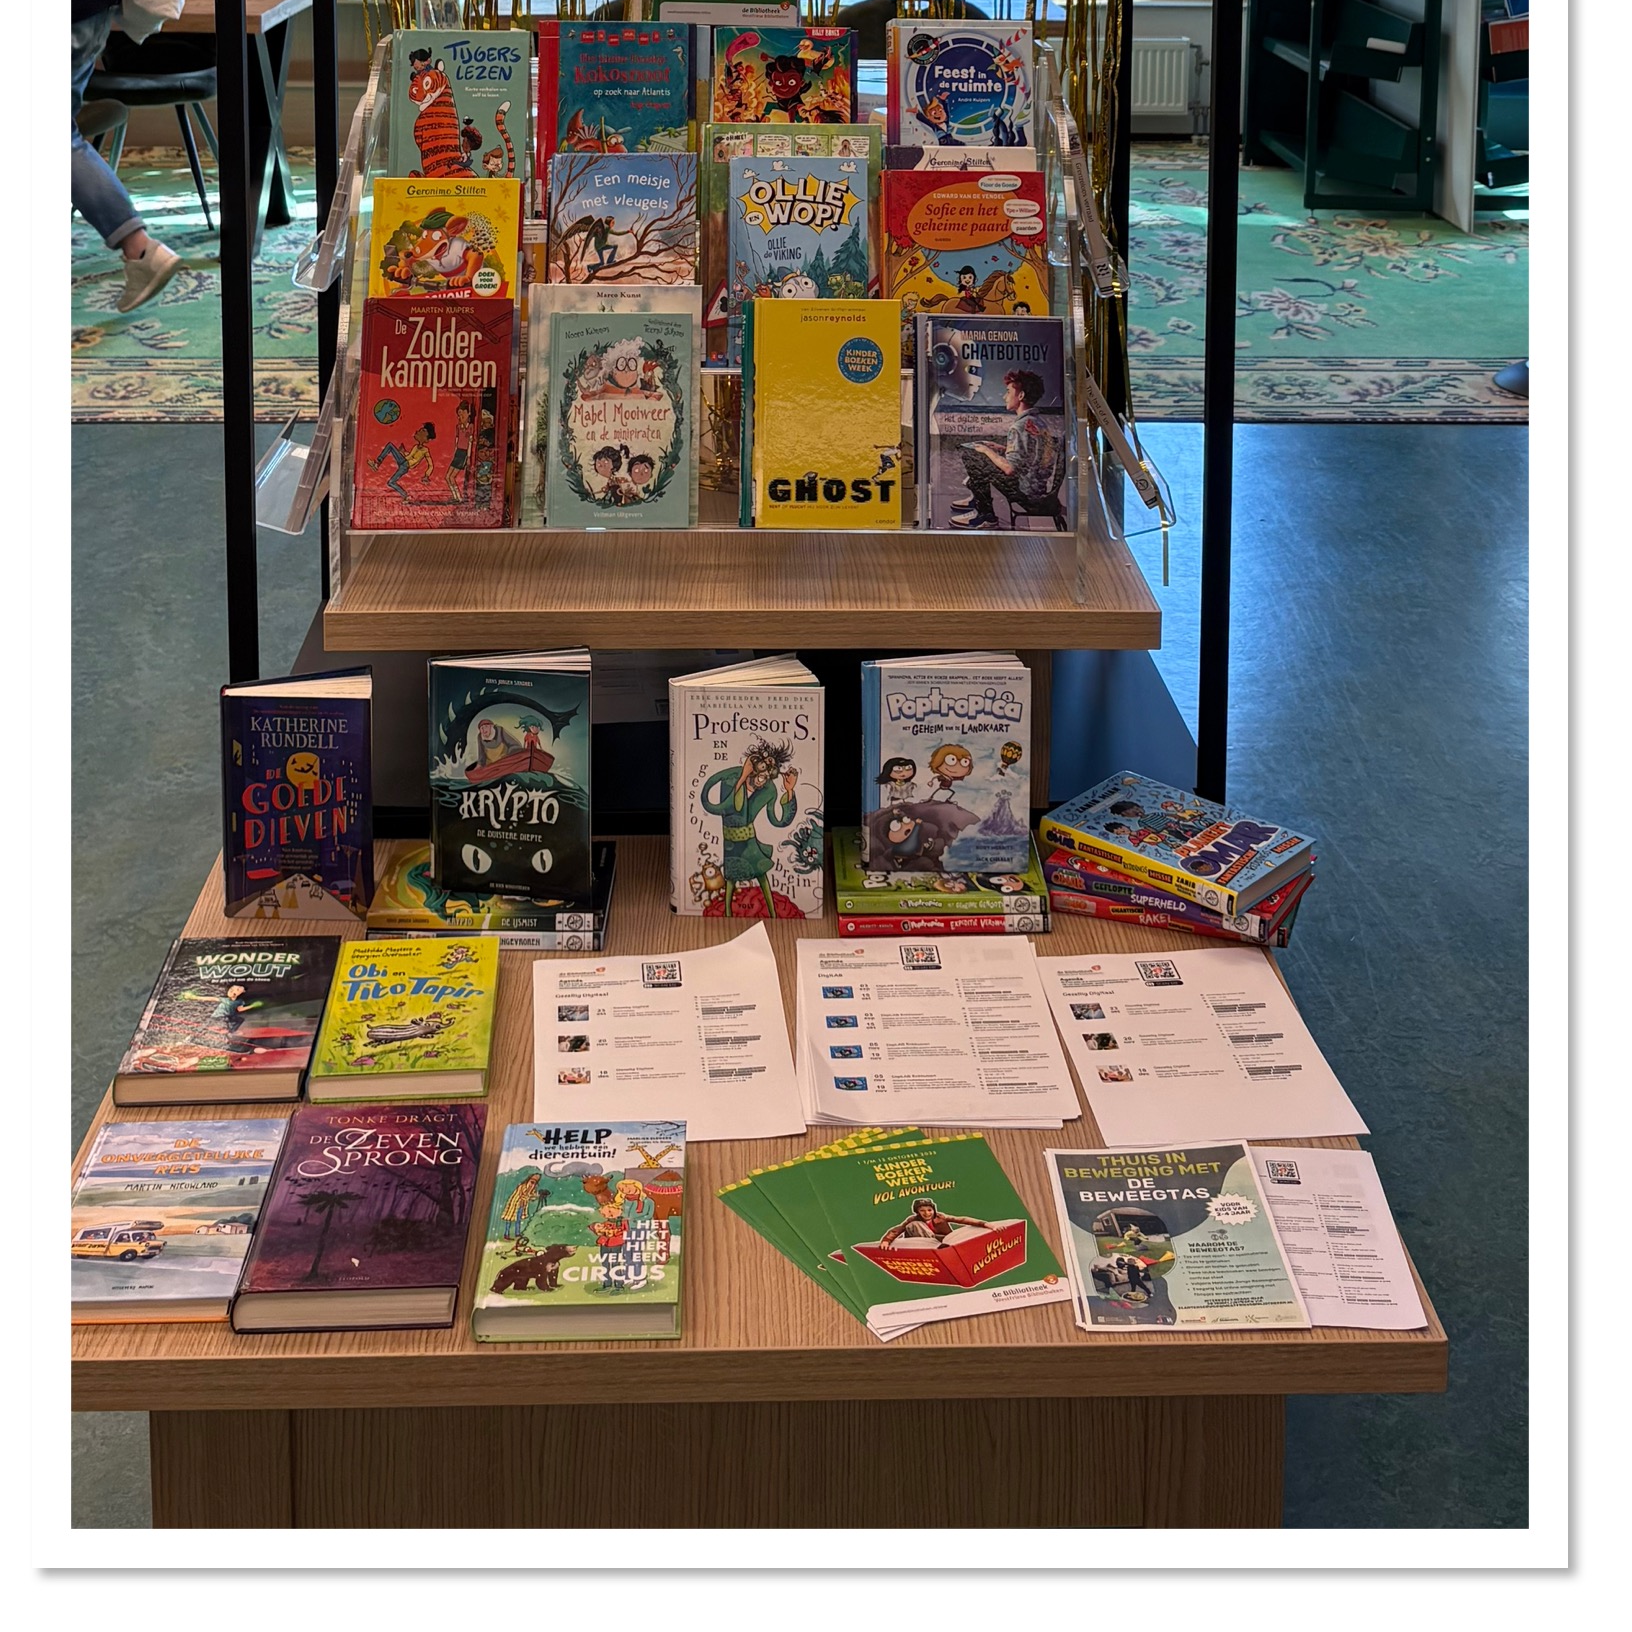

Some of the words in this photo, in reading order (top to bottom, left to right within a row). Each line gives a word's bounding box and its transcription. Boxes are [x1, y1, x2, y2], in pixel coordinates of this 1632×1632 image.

[443, 41, 521, 64] TIJGERS
[455, 65, 513, 82] LEZEN
[934, 66, 976, 80] Feest
[977, 71, 986, 79] in
[939, 82, 949, 91] de
[951, 76, 1002, 93] ruimte
[593, 88, 602, 98] op
[605, 87, 622, 97] zoek
[624, 88, 640, 97] naar
[641, 87, 671, 97] Atlantis
[595, 175, 621, 188] Een
[627, 172, 670, 190] meisje
[406, 185, 452, 197] Geronimo
[454, 185, 487, 196] Stilton
[749, 179, 850, 207] OLLIE
[582, 196, 608, 210] met
[615, 193, 669, 211] vleugels
[748, 213, 761, 224] EN
[765, 202, 844, 232] WOP!
[925, 204, 955, 218] Sofie
[959, 205, 976, 216] en
[978, 203, 998, 216] het
[914, 218, 964, 235] geheime
[967, 218, 1010, 233] paard
[768, 236, 788, 251] OLLIE
[620, 291, 641, 299] Kunst
[410, 305, 443, 314] MAARTEN
[446, 305, 474, 314] KUIPERS
[395, 321, 406, 336] De
[406, 317, 483, 360] Zolder
[961, 330, 986, 342] MARIA
[988, 330, 1019, 342] GENOVA
[846, 350, 877, 359] KINDER
[961, 343, 1048, 363] CHATBOTBOY
[845, 356, 878, 366] BOEKEN
[848, 364, 872, 372] WEEK
[380, 346, 497, 402] kampioen
[574, 404, 607, 426] Mabel
[613, 404, 670, 425] Mooiweer
[613, 426, 662, 444] minipiraten
[769, 472, 896, 504] GHOST
[885, 687, 1024, 723] Poptropica
[250, 716, 349, 734] KATHERINE
[692, 713, 791, 741] Professor
[793, 714, 816, 741] S.
[912, 723, 944, 735] GEHEIM
[962, 722, 1010, 734] LANDKAART
[261, 732, 339, 750] RUNDELL
[242, 775, 347, 814] GOEDE
[460, 781, 560, 827] KRYPTO
[244, 806, 348, 849] DIEVEN
[477, 829, 486, 838] DE
[488, 829, 517, 840] DUISTERE
[520, 832, 542, 842] DIEPTE
[1178, 821, 1282, 876] OMAR
[1131, 894, 1186, 912] SUPERHELD
[195, 952, 300, 965] WONDER
[198, 964, 291, 979] WOUT
[348, 964, 387, 980] Obi
[342, 980, 406, 1002] Tito
[409, 976, 485, 1003] Tapir
[326, 1115, 387, 1125] TONKE
[395, 1113, 458, 1124] DRAGT
[309, 1134, 332, 1144] DE
[333, 1127, 460, 1151] ZEVEN
[100, 1149, 265, 1163] ONVERGETELIJKE
[297, 1145, 463, 1176] SPRONG
[528, 1149, 617, 1160] dierentuin!
[1097, 1154, 1161, 1167] THUIS
[1165, 1152, 1187, 1164] IN
[154, 1163, 201, 1175] REIS
[873, 1158, 927, 1173] KINDER
[1064, 1165, 1173, 1178] BEWEGING
[1178, 1162, 1220, 1175] MET
[875, 1166, 933, 1181] BOEKEN
[886, 1174, 929, 1188] WEEK
[124, 1182, 163, 1191] MARTIN
[170, 1181, 218, 1190] NIEUWLAND
[1128, 1178, 1155, 1189] DE
[873, 1191, 895, 1205] VOL
[898, 1181, 956, 1198] AVONTUUR!
[1079, 1188, 1210, 1202] BEWEEGTAS
[637, 1220, 669, 1229] HET
[623, 1230, 669, 1240] LIJKT
[626, 1241, 667, 1251] HIER
[588, 1253, 626, 1263] WEL
[632, 1252, 666, 1262] EEN
[973, 1235, 1022, 1274] AVONTUUR!
[562, 1265, 666, 1282] CIRCUS
[1003, 1285, 1048, 1296] Bibliotheek
